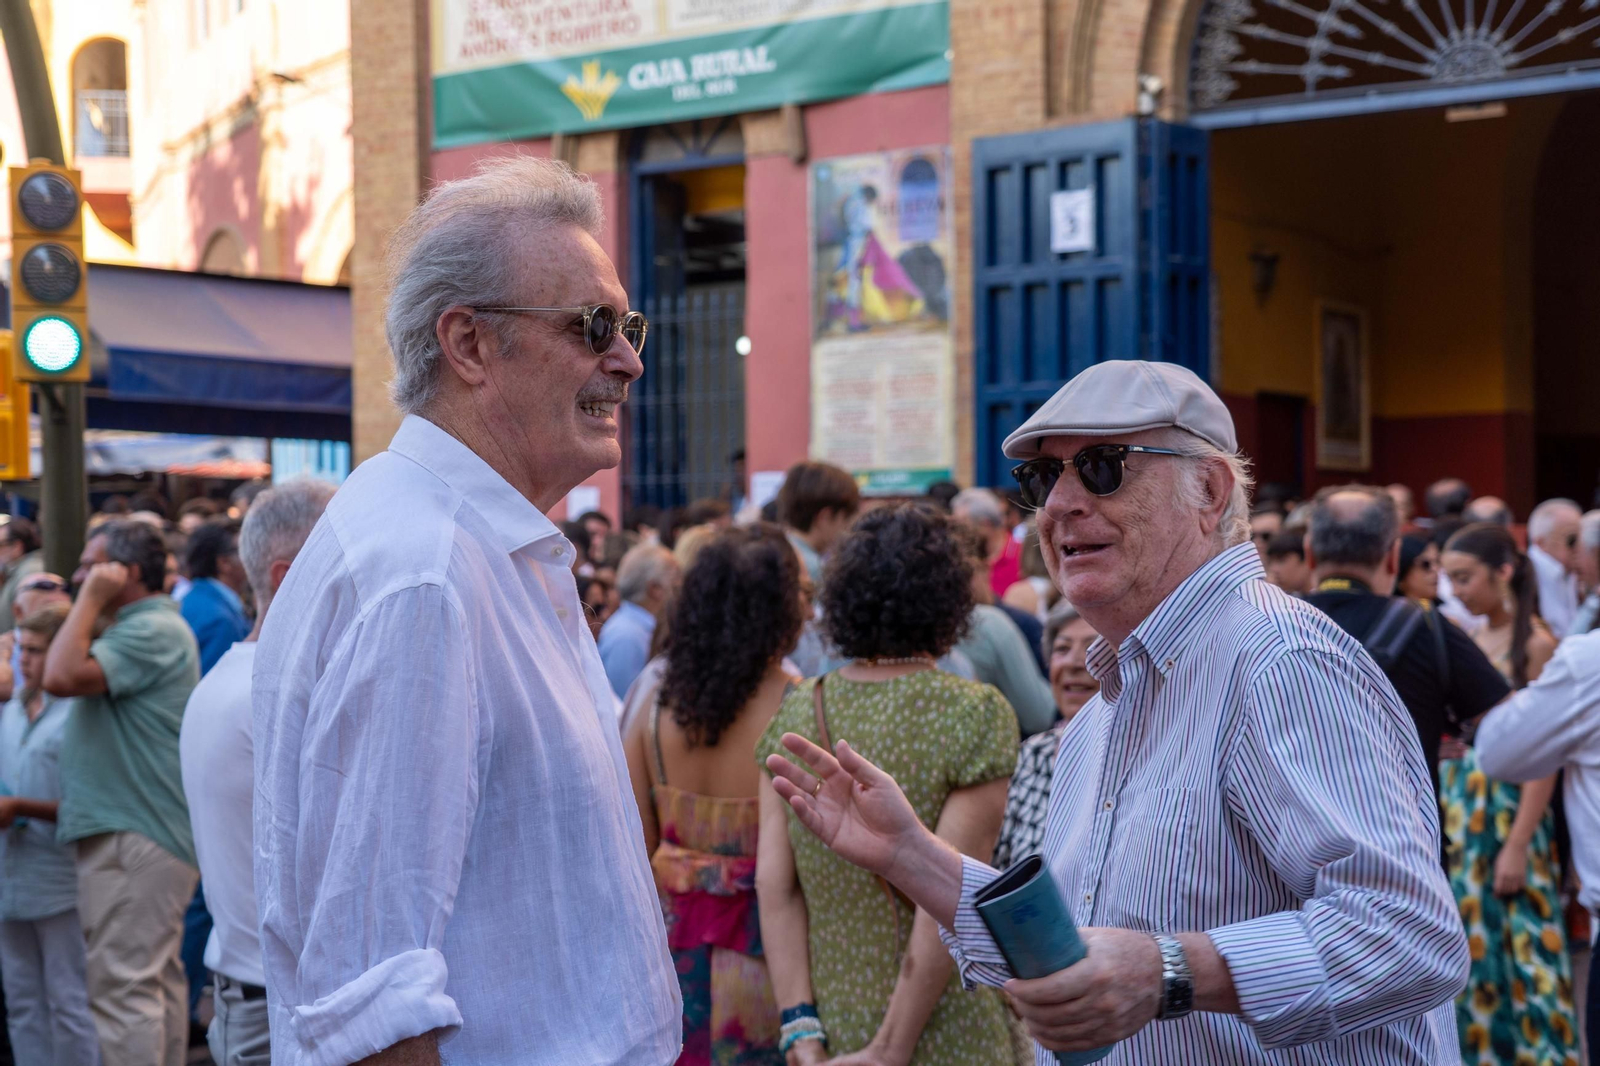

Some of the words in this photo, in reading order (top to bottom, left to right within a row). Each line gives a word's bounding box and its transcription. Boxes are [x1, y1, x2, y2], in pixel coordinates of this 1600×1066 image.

[545, 13, 642, 46] ROMERO
[628, 57, 687, 90] CAJA
[689, 45, 777, 81] RURAL
